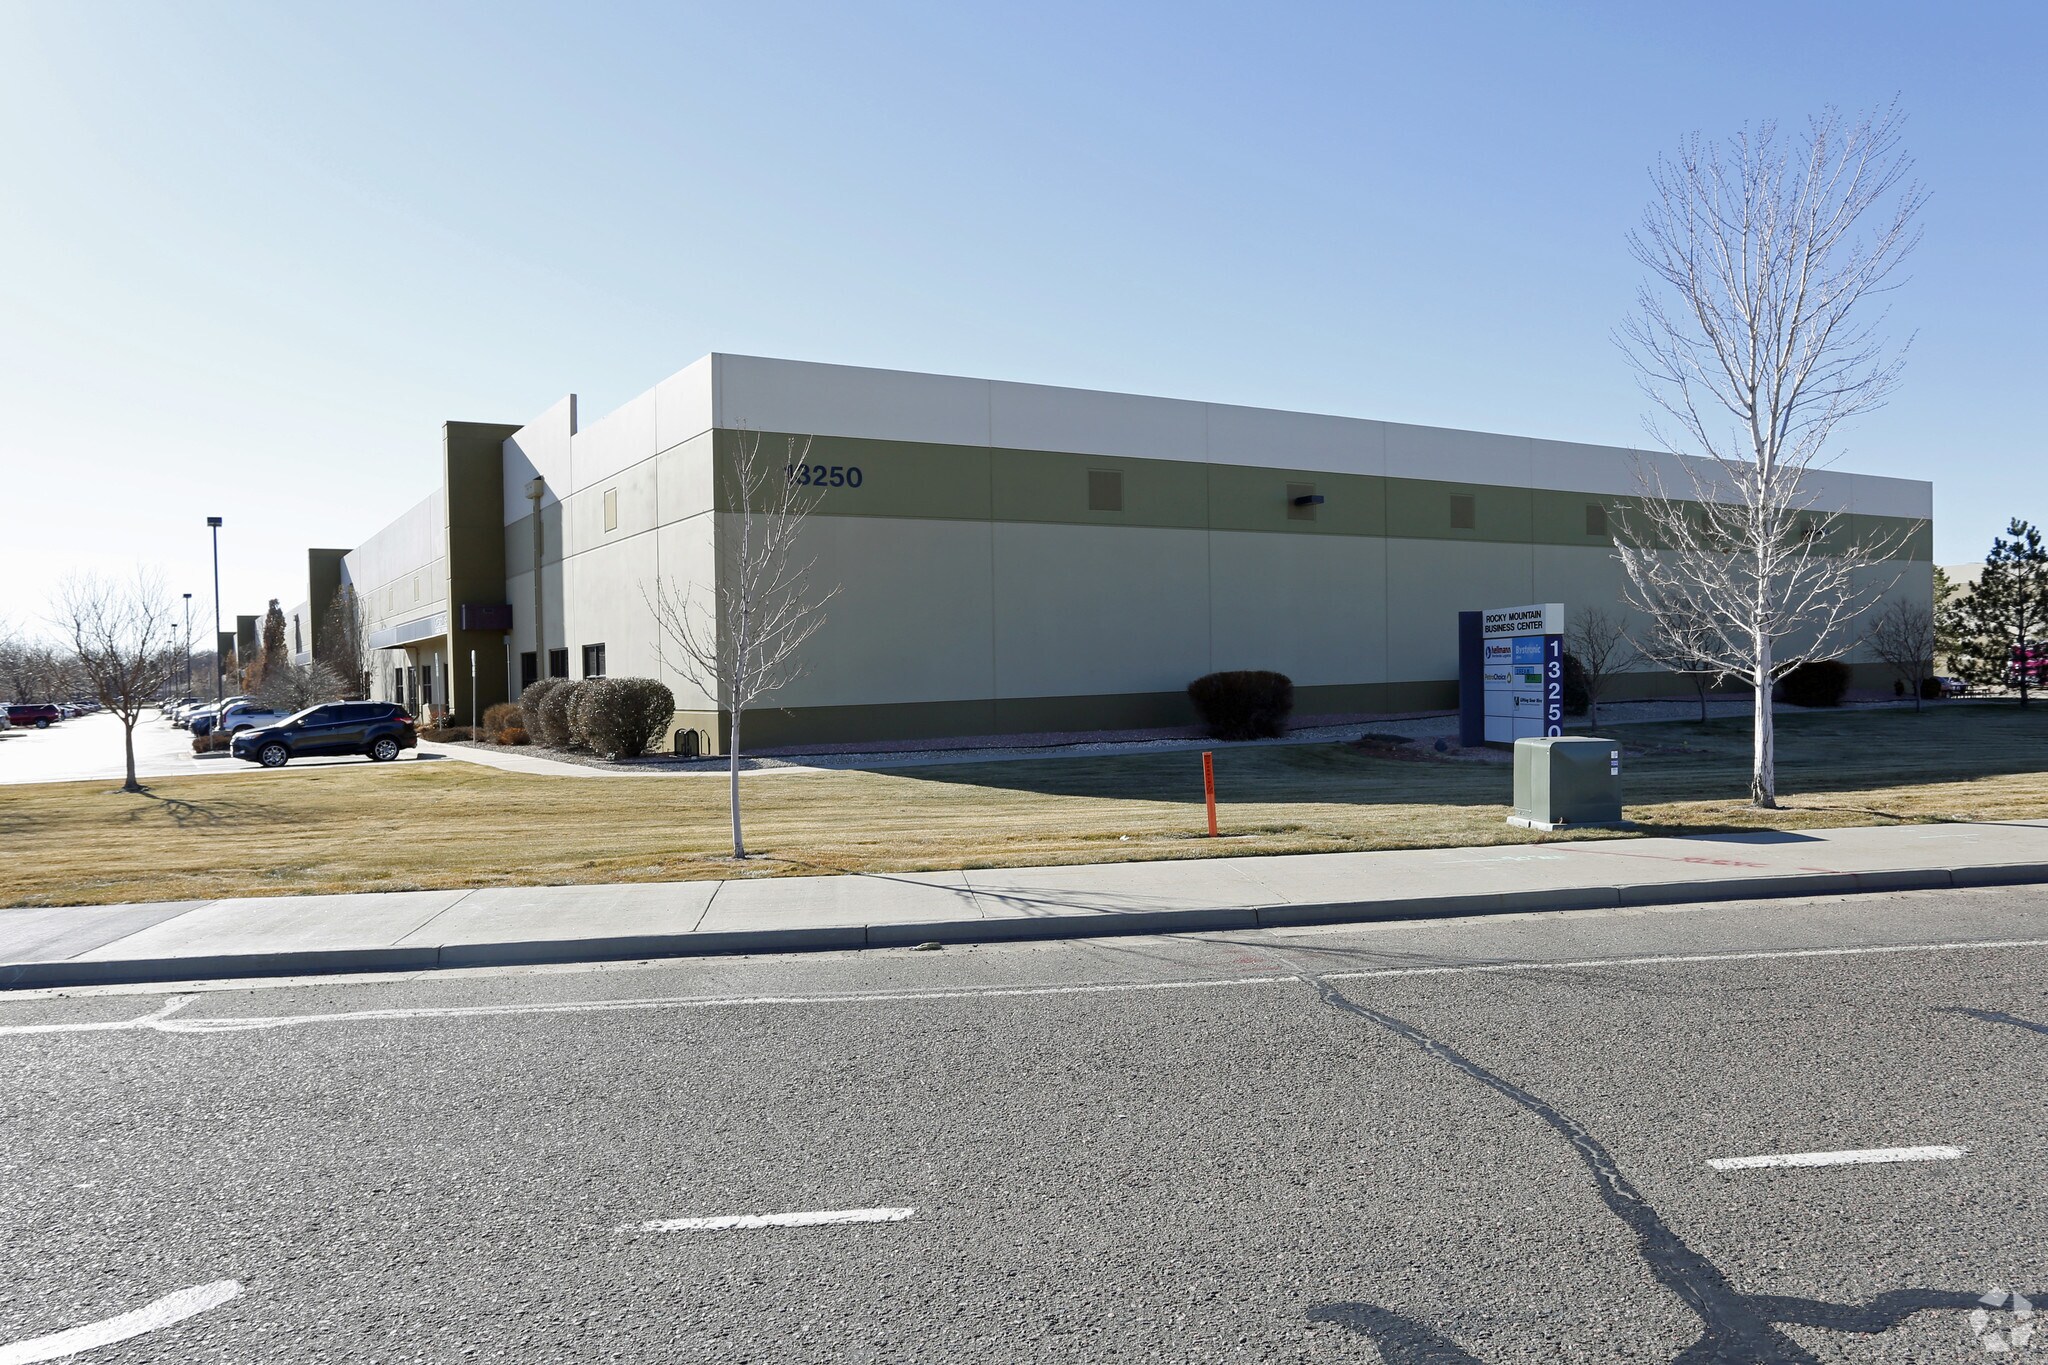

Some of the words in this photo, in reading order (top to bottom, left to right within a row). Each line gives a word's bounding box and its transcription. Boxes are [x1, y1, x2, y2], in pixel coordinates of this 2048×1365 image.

[784, 463, 863, 488] 13250
[1486, 613, 1507, 624] ROCKY
[1508, 610, 1542, 621] MOUNTAIN
[1485, 623, 1515, 633] BUSINESS
[1516, 620, 1543, 631] CENTER
